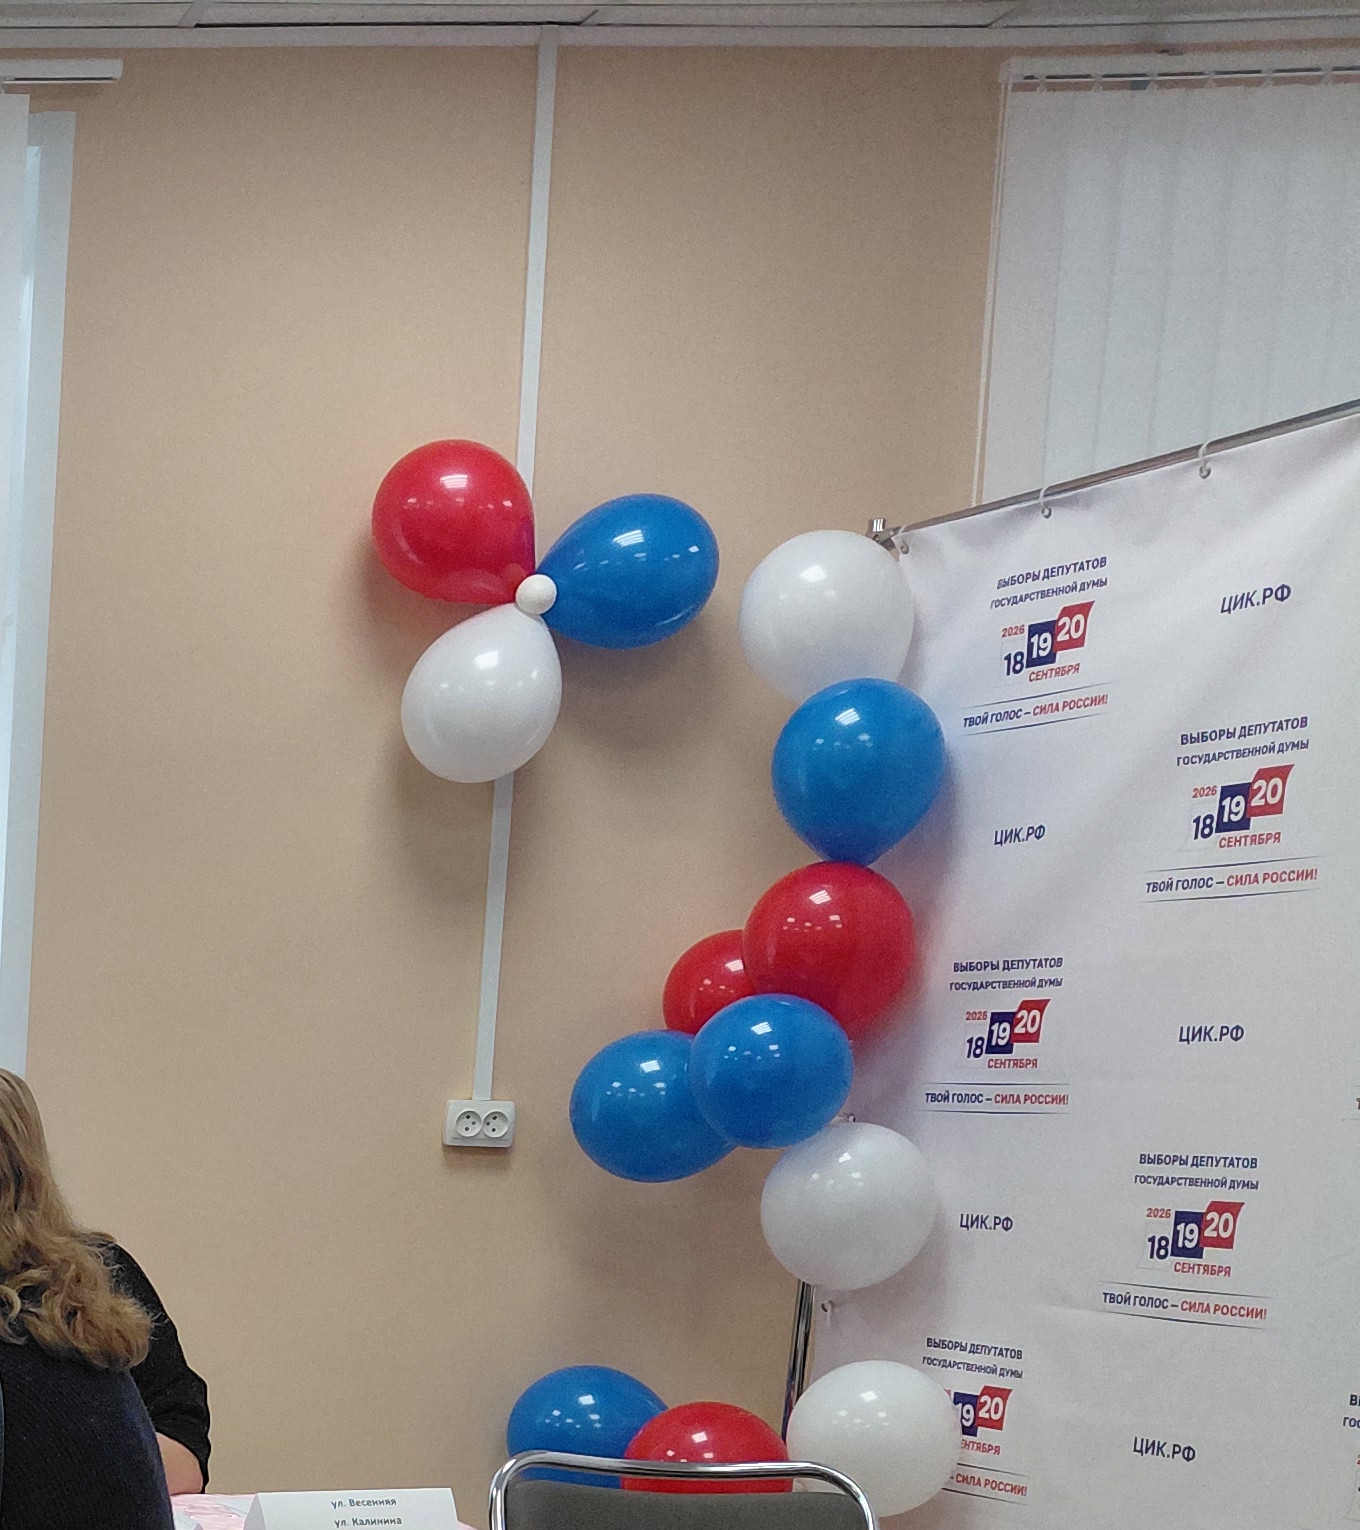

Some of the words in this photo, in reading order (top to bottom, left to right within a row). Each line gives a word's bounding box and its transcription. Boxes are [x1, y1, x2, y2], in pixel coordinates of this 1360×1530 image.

[997, 567, 1041, 589] ВЫБОРЫ
[1042, 556, 1107, 581] ДЕПУТАТОВ
[990, 582, 1078, 609] ГОСУДАРСТВЕННОЙ
[1079, 577, 1108, 593] ДУМЫ
[1220, 583, 1292, 614] ЦИК.РФ
[1001, 625, 1025, 639] 2026
[1004, 650, 1024, 676] 18
[1030, 632, 1052, 658] 19
[1056, 614, 1085, 641] 20
[1028, 663, 1080, 682] СЕНТЯБРЯ
[963, 711, 989, 728] ТВОЙ
[990, 708, 1022, 724] ГОЛОС
[1033, 701, 1060, 717] СИЛА
[1062, 694, 1108, 713] РОССИИ!
[1180, 727, 1236, 746] ВЫБОРЫ
[1238, 716, 1308, 740] ДЕПУТАТОВ
[1177, 743, 1275, 766] ГОСУДАРСТВЕННОЙ
[1277, 739, 1309, 755] ДУМЫ
[1192, 786, 1217, 799] 2026
[1192, 814, 1214, 839] 18
[1221, 796, 1245, 822] 19
[1251, 777, 1282, 805] 20
[994, 824, 1046, 847] ЦИК.РФ
[1219, 832, 1281, 849] СЕНТЯБРЯ
[1146, 876, 1173, 894] ТВОЙ
[1175, 875, 1214, 891] ГОЛОС
[1226, 871, 1259, 887] СИЛА
[1262, 868, 1318, 885] РОССИИ!
[953, 960, 1000, 974] ВЫБОРЫ
[1002, 956, 1063, 971] ДЕПУТАТОВ
[949, 976, 1036, 991] ГОСУДАРСТВЕННОЙ
[1037, 977, 1063, 988] ДУМЫ
[966, 1011, 987, 1022] 2026
[966, 1036, 985, 1058] 18
[991, 1021, 1010, 1046] 19
[1014, 1009, 1041, 1034] 20
[1178, 1025, 1245, 1045] ЦИК.РФ
[987, 1058, 1038, 1069] СЕНТЯБРЯ
[925, 1089, 950, 1104] ТВОЙ
[951, 1092, 984, 1105] ГОЛОС
[994, 1093, 1022, 1105] СИЛА
[1024, 1093, 1069, 1106] РОССИИ!
[1139, 1154, 1188, 1167] ВЫБОРЫ
[1191, 1155, 1258, 1170] ДЕПУТАТОВ
[1134, 1174, 1227, 1190] ГОСУДАРСТВЕННОЙ
[1228, 1178, 1259, 1191] ДУМЫ
[959, 1213, 1013, 1232] ЦИК.РФ
[1146, 1207, 1171, 1220] 2026
[1147, 1235, 1169, 1260] 18
[1176, 1223, 1199, 1248] 19
[1204, 1212, 1234, 1238] 20
[1173, 1261, 1231, 1278] СЕНТЯБРЯ
[1102, 1291, 1131, 1307] ТВОЙ
[1132, 1295, 1168, 1310] ГОЛОС
[1180, 1300, 1211, 1316] СИЛА
[1213, 1305, 1267, 1321] РОССИИ!
[927, 1338, 967, 1352] ВЫБОРЫ
[968, 1344, 1022, 1360] ДЕПУТАТОВ
[922, 1356, 997, 1375] ГОСУДАРСТВЕННОЙ
[999, 1368, 1023, 1379] ДУМЫ
[979, 1395, 1003, 1420] 20
[1132, 1437, 1196, 1463] ЦИК.РФ
[956, 1473, 981, 1487] СИЛА
[984, 1479, 1027, 1496] РОССИИ!
[331, 1499, 347, 1509] ул.
[349, 1498, 397, 1508] Весенняя
[334, 1518, 349, 1528] ул.
[351, 1517, 402, 1526] Калинина
